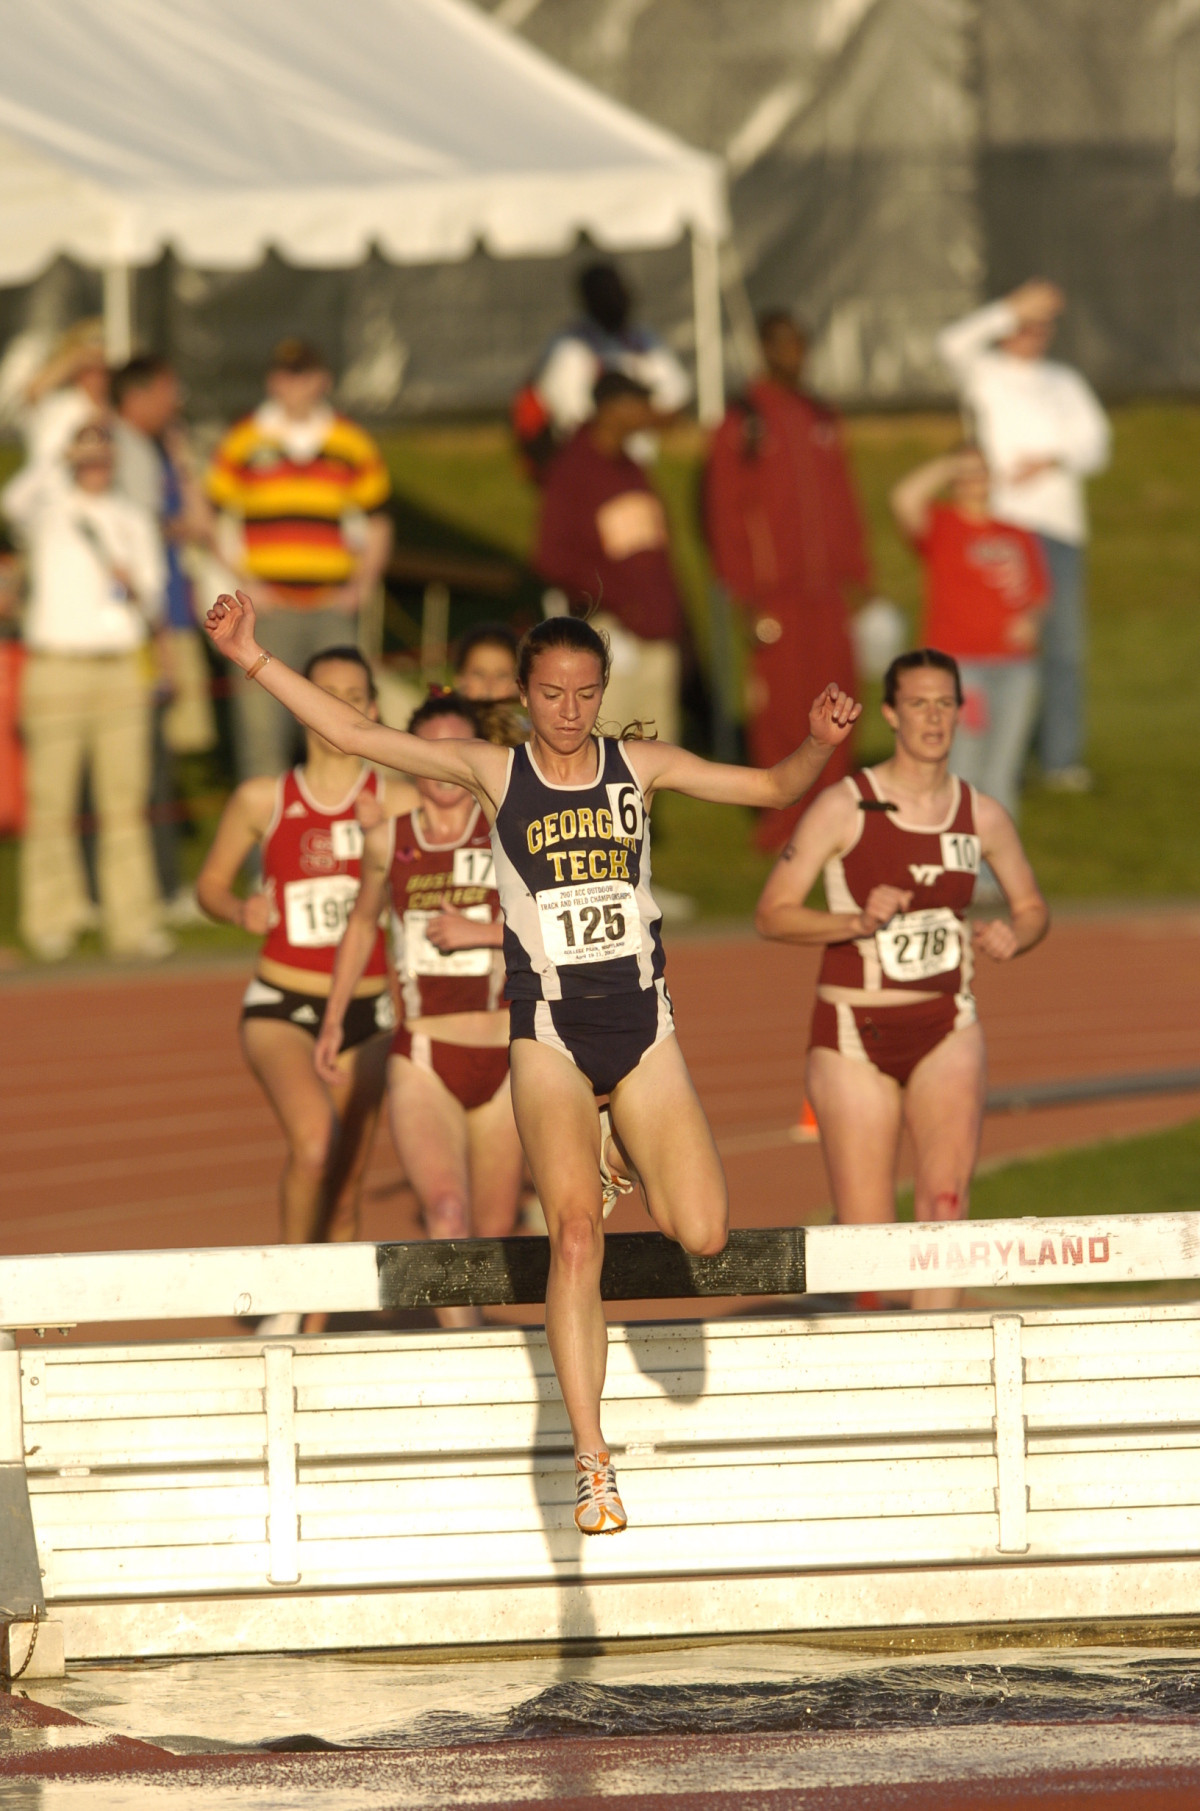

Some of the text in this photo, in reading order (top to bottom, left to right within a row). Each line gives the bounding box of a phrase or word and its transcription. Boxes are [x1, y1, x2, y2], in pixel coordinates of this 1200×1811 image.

[618, 786, 637, 835] 6
[526, 808, 637, 854] GEORG
[464, 853, 493, 881] 17
[546, 850, 630, 881] TECH
[952, 837, 977, 869] 10
[909, 864, 945, 886] VT
[540, 892, 632, 911] TRACK AND FIELD CHAMPIONSHIPS
[560, 885, 614, 899] 2007 ACC OUTDOOR
[557, 903, 625, 947] 125
[894, 927, 948, 963] 278
[909, 1236, 1110, 1271] MARYLAND
